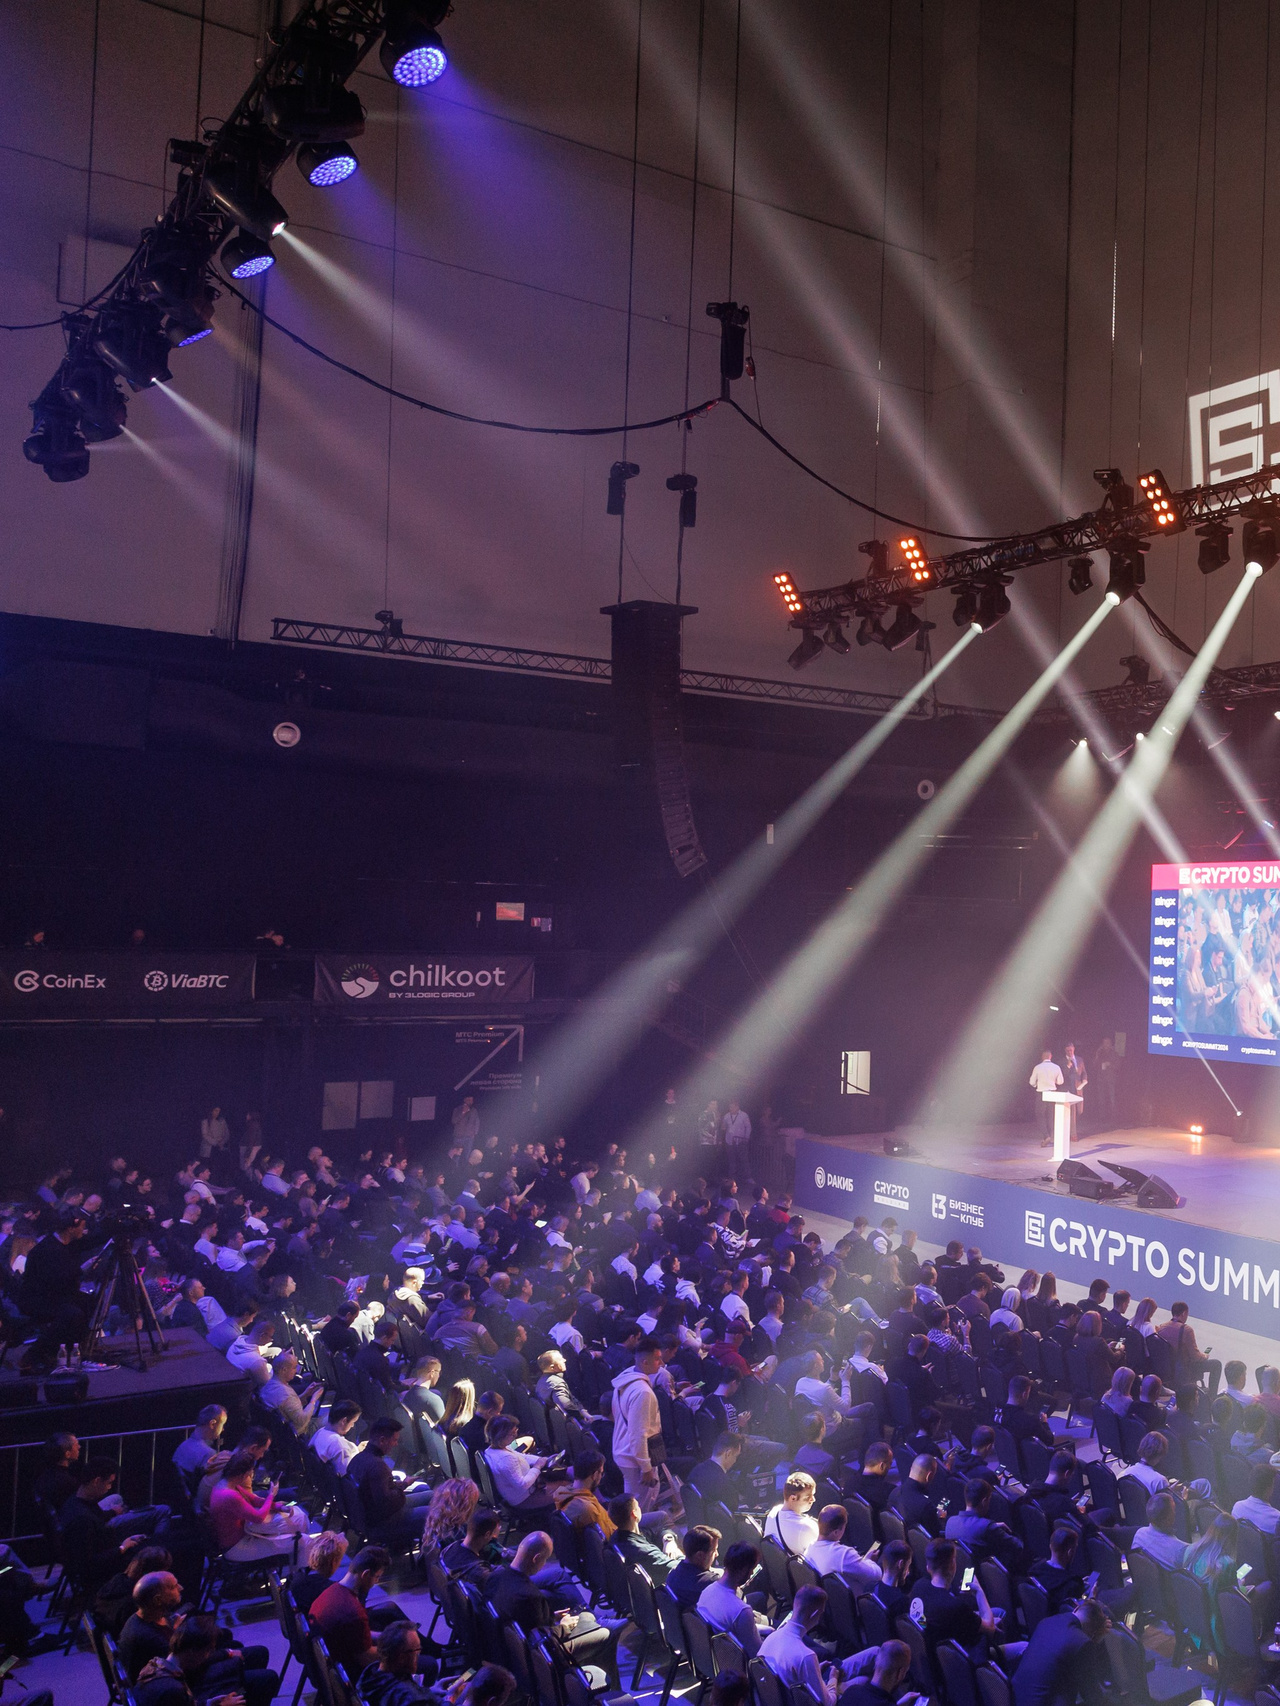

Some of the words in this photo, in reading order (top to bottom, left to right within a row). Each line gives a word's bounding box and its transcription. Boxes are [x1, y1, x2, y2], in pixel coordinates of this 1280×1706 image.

[1191, 866, 1250, 884] CRYPTO
[43, 974, 106, 988] CoinEx
[171, 974, 229, 988] ViaBTC
[389, 964, 506, 987] chilkoot
[827, 1173, 854, 1192] РАКИБ
[874, 1180, 909, 1199] CRYPTO
[949, 1200, 984, 1216] БИЗНЕС
[960, 1215, 984, 1228] КЛУБ
[1049, 1217, 1170, 1279] CRYPTO
